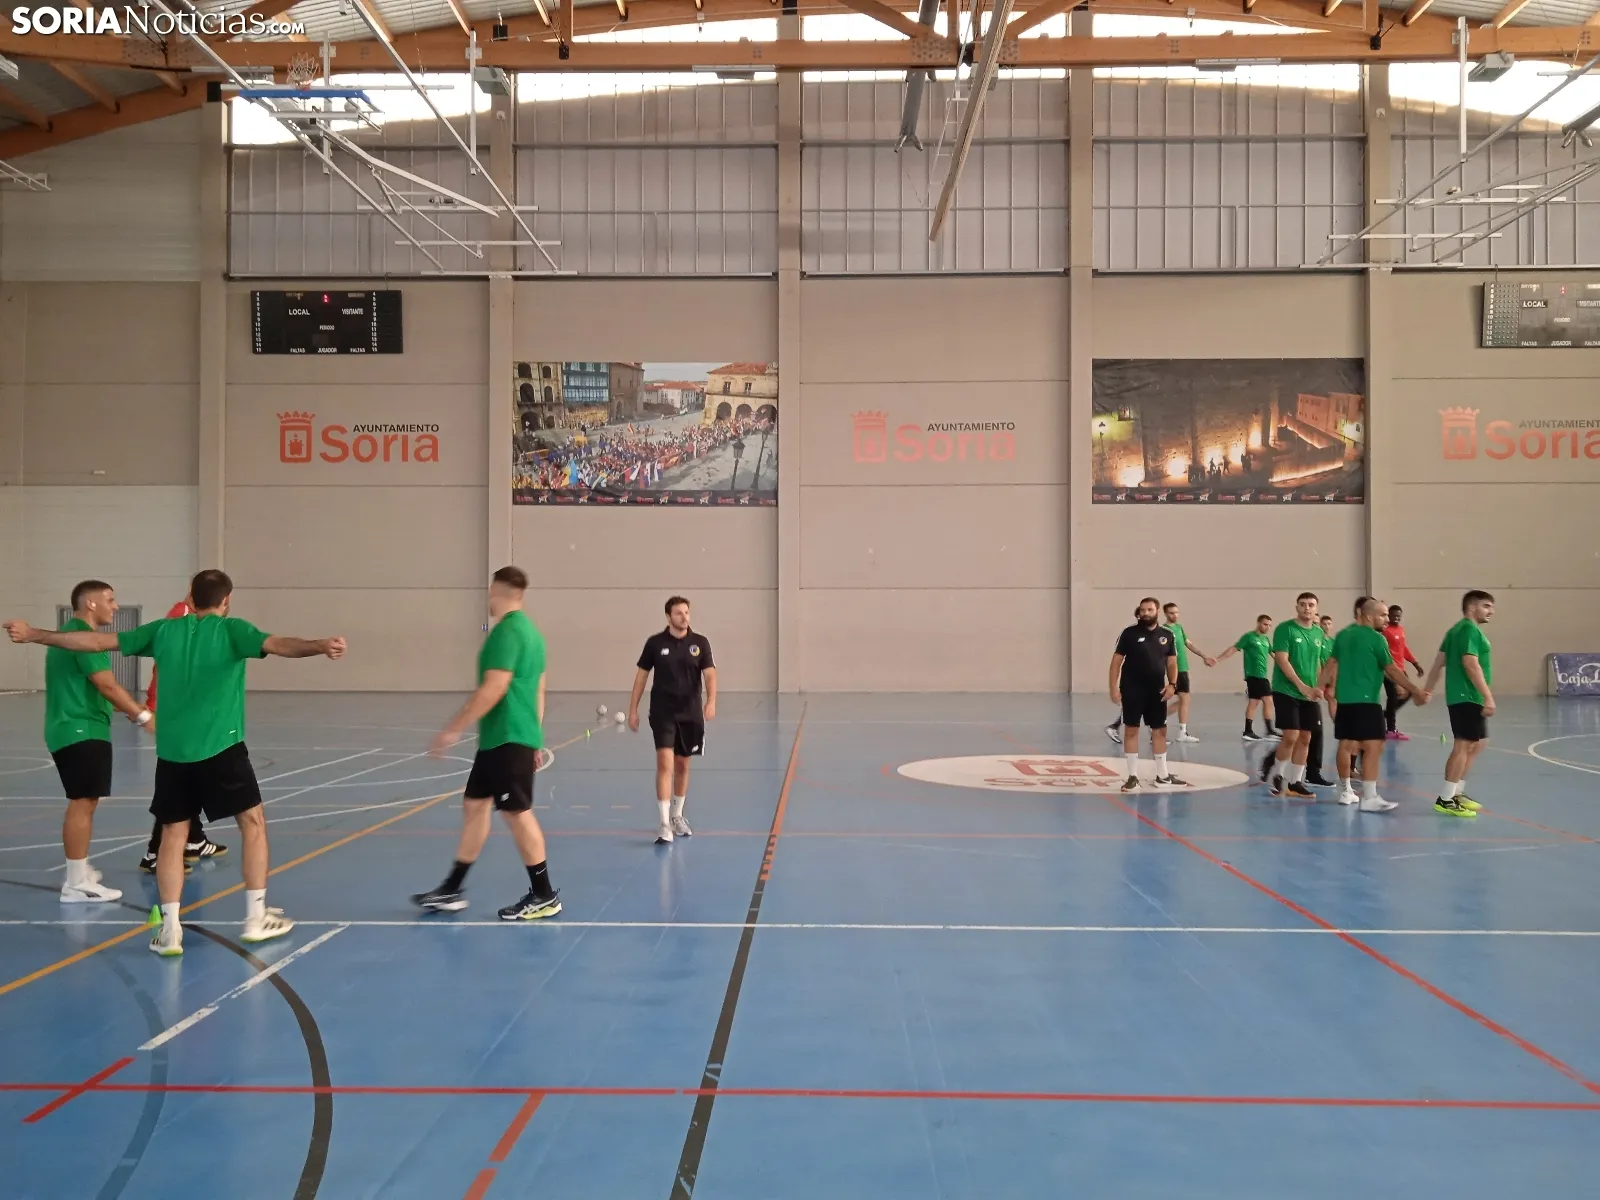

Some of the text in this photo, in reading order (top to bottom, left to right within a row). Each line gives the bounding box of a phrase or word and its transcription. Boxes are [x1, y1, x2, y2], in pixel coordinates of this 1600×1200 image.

[1523, 300, 1546, 308] LOCAL
[288, 308, 310, 316] LOCAL
[353, 424, 439, 433] AYUNTAMIENTO
[927, 422, 1015, 432] AYUNTAMIENTO
[319, 424, 439, 464] Soria
[893, 423, 1016, 463] Soria
[1484, 419, 1600, 461] Soria
